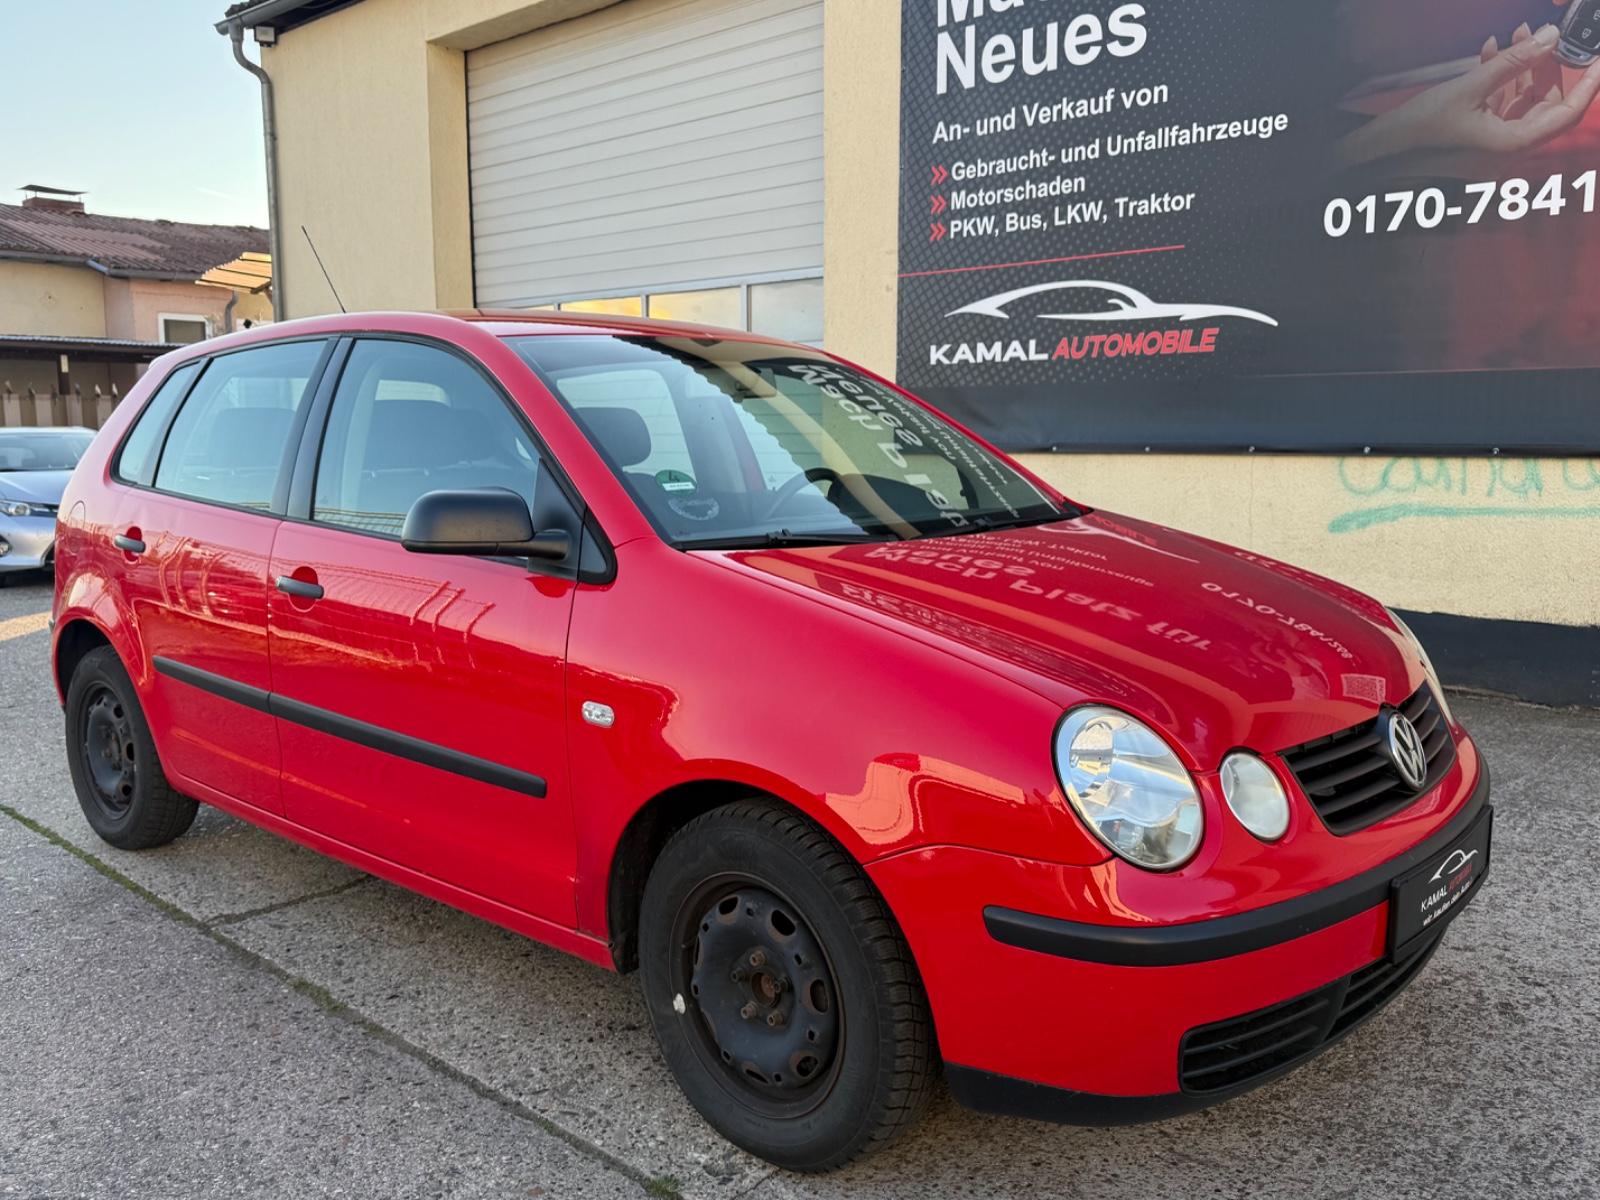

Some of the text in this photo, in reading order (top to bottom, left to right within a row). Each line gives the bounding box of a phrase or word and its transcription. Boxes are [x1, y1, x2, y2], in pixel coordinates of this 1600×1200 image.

[936, 2, 1147, 95] Neues
[932, 84, 1169, 144] An- und Verkauf von
[951, 111, 1289, 182] Gebraucht- und Unfallfahrzeuge
[950, 176, 1086, 211] Motorschaden
[950, 190, 1196, 240] PKW, Bus, LKW, Traktor
[1323, 169, 1597, 238] 0170-7841
[929, 327, 1220, 366] KAMAL AUTOMOBILE
[1420, 884, 1448, 913] KAMAL
